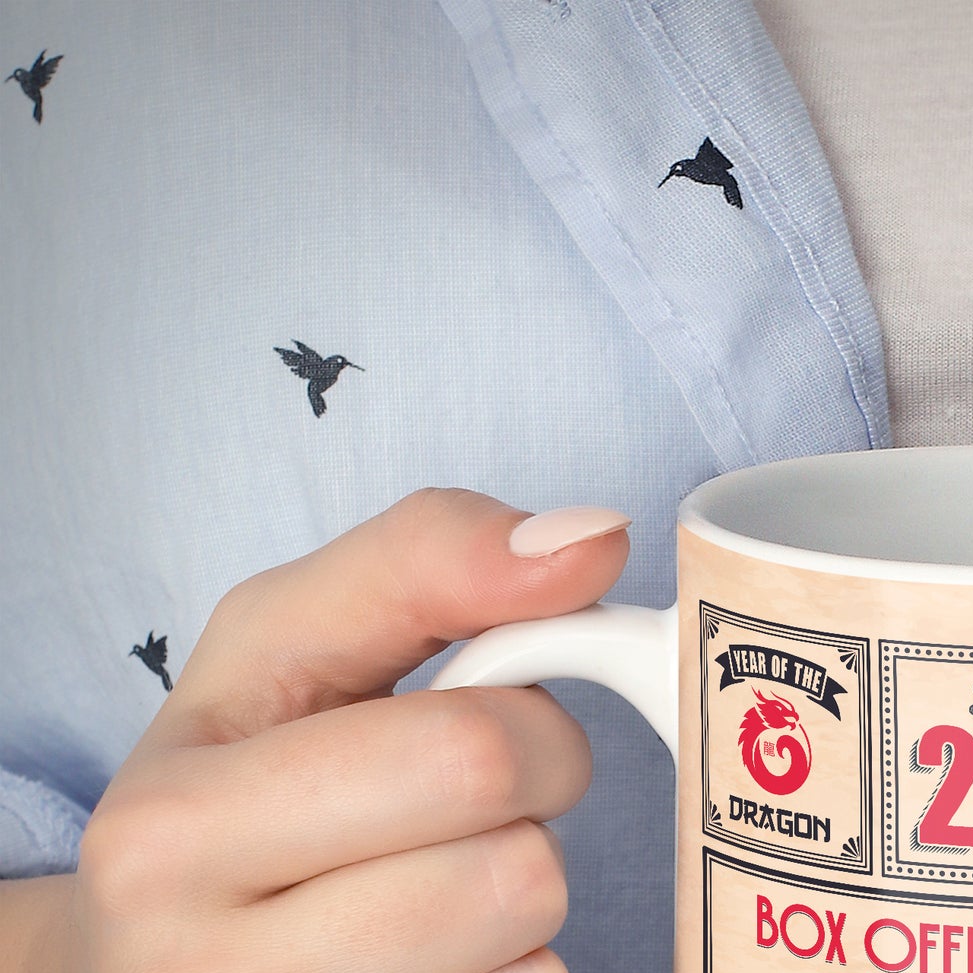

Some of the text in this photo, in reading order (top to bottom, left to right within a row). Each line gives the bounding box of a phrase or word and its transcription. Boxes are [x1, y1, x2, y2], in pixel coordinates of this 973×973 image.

[733, 650, 823, 693] YEAR OF THE
[729, 794, 831, 843] DRAGON
[757, 894, 847, 966] BOX
